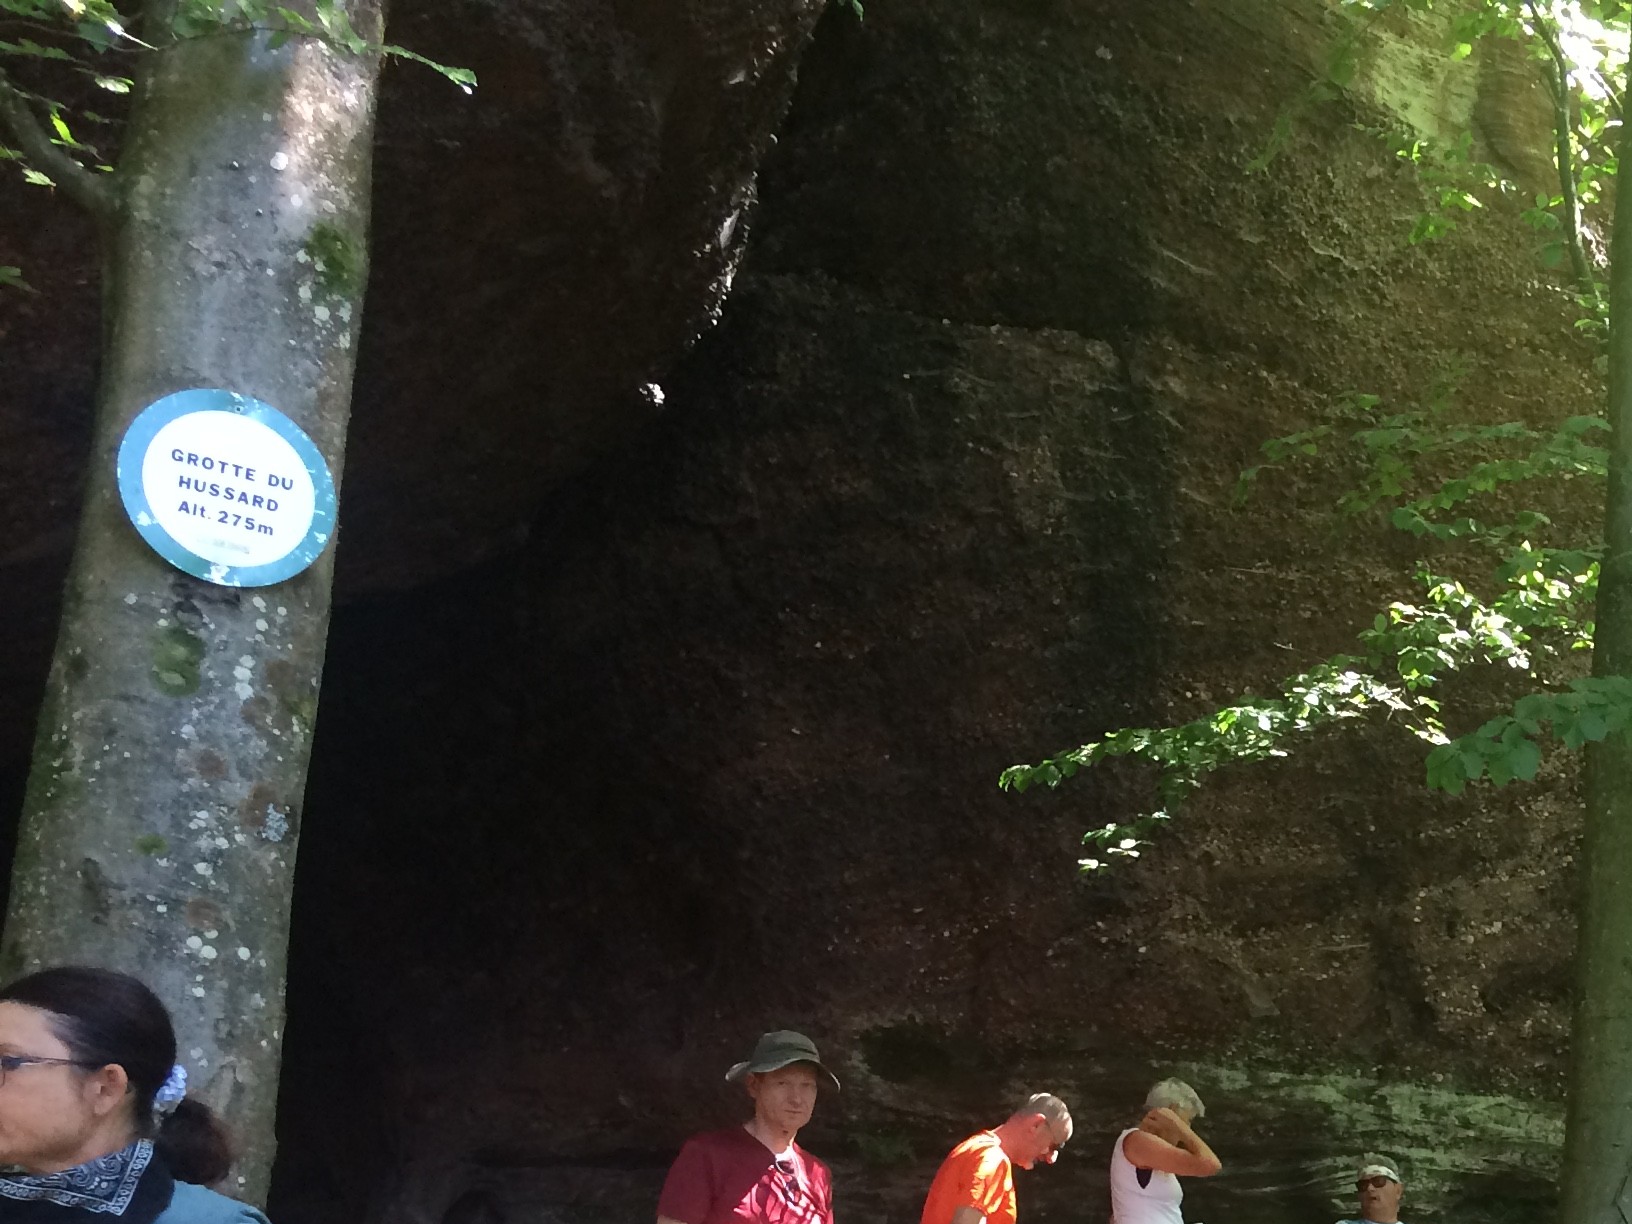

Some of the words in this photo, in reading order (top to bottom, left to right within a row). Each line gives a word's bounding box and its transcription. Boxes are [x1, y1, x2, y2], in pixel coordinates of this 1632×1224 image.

[171, 448, 257, 482] GROTTE
[267, 473, 294, 491] DU
[178, 475, 279, 512] HUSSARD
[177, 500, 211, 520] Alt.
[217, 510, 274, 536] 275m
